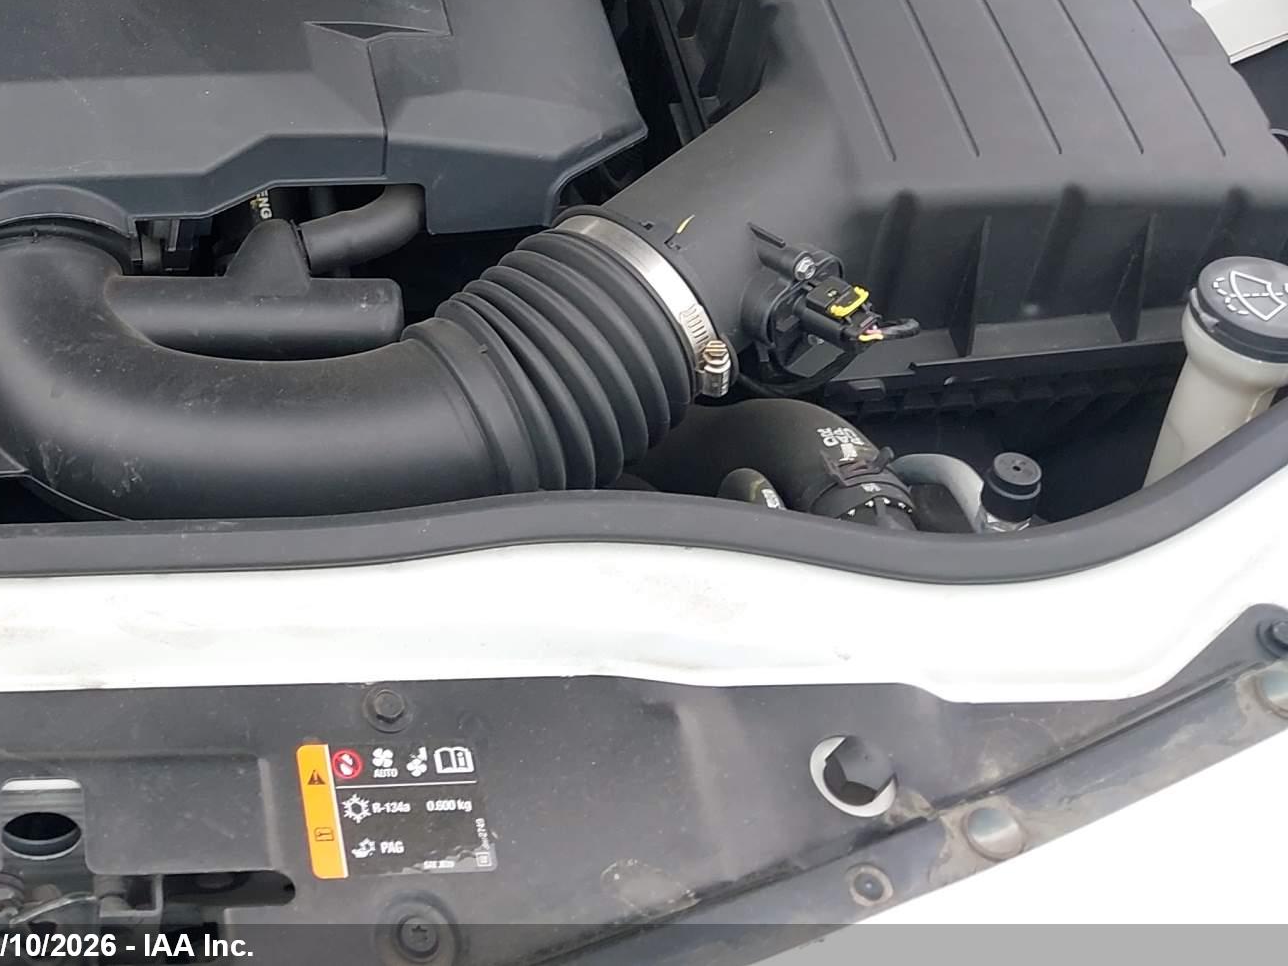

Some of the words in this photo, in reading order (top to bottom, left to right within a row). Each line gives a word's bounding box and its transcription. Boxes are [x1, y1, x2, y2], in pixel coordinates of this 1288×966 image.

[373, 768, 398, 778] AUTO
[371, 801, 411, 813] R-134a
[457, 799, 473, 813] kg
[380, 841, 405, 854] PAG
